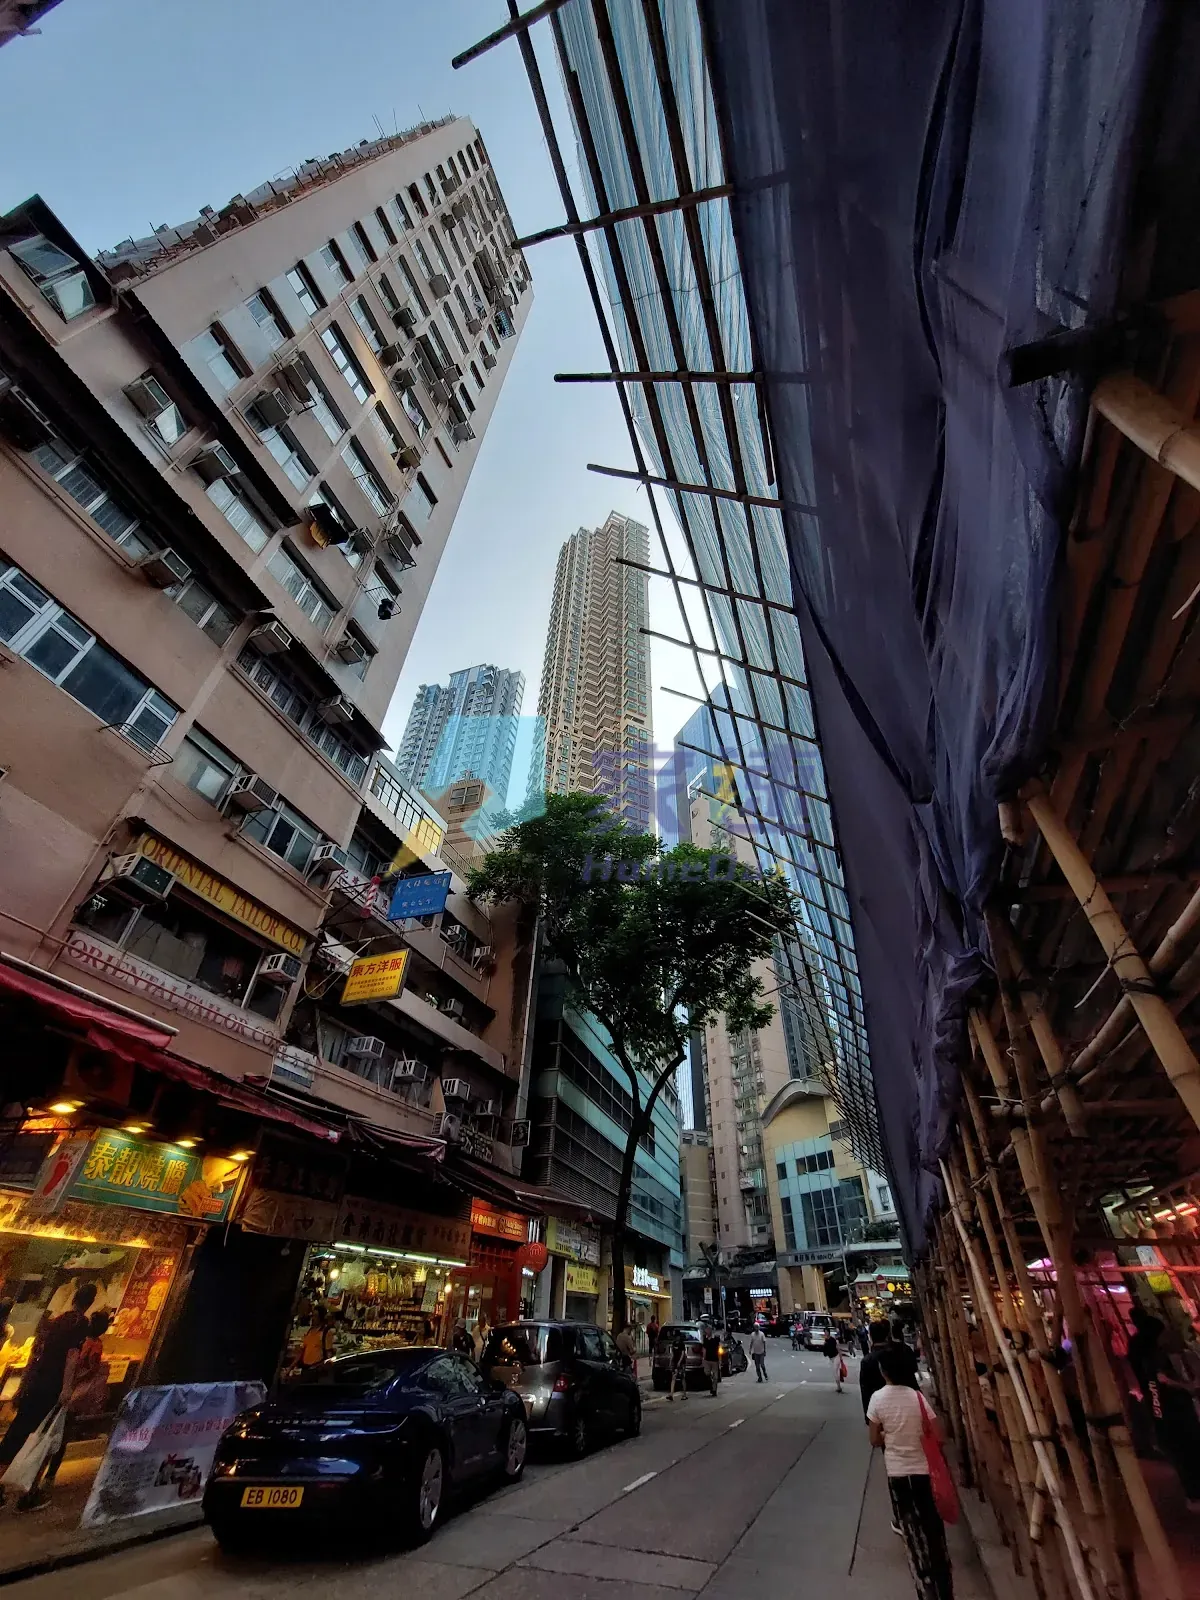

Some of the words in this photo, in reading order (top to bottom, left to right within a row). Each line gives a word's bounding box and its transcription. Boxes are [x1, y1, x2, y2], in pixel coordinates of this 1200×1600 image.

[142, 836, 223, 904] ORIENTAL
[229, 891, 280, 938] TAILOR
[67, 938, 180, 1005] ORIENTAL
[183, 991, 248, 1036] TAILOR
[351, 957, 402, 977] 東方洋服
[246, 1489, 264, 1504] EB
[267, 1489, 297, 1504] 1080
